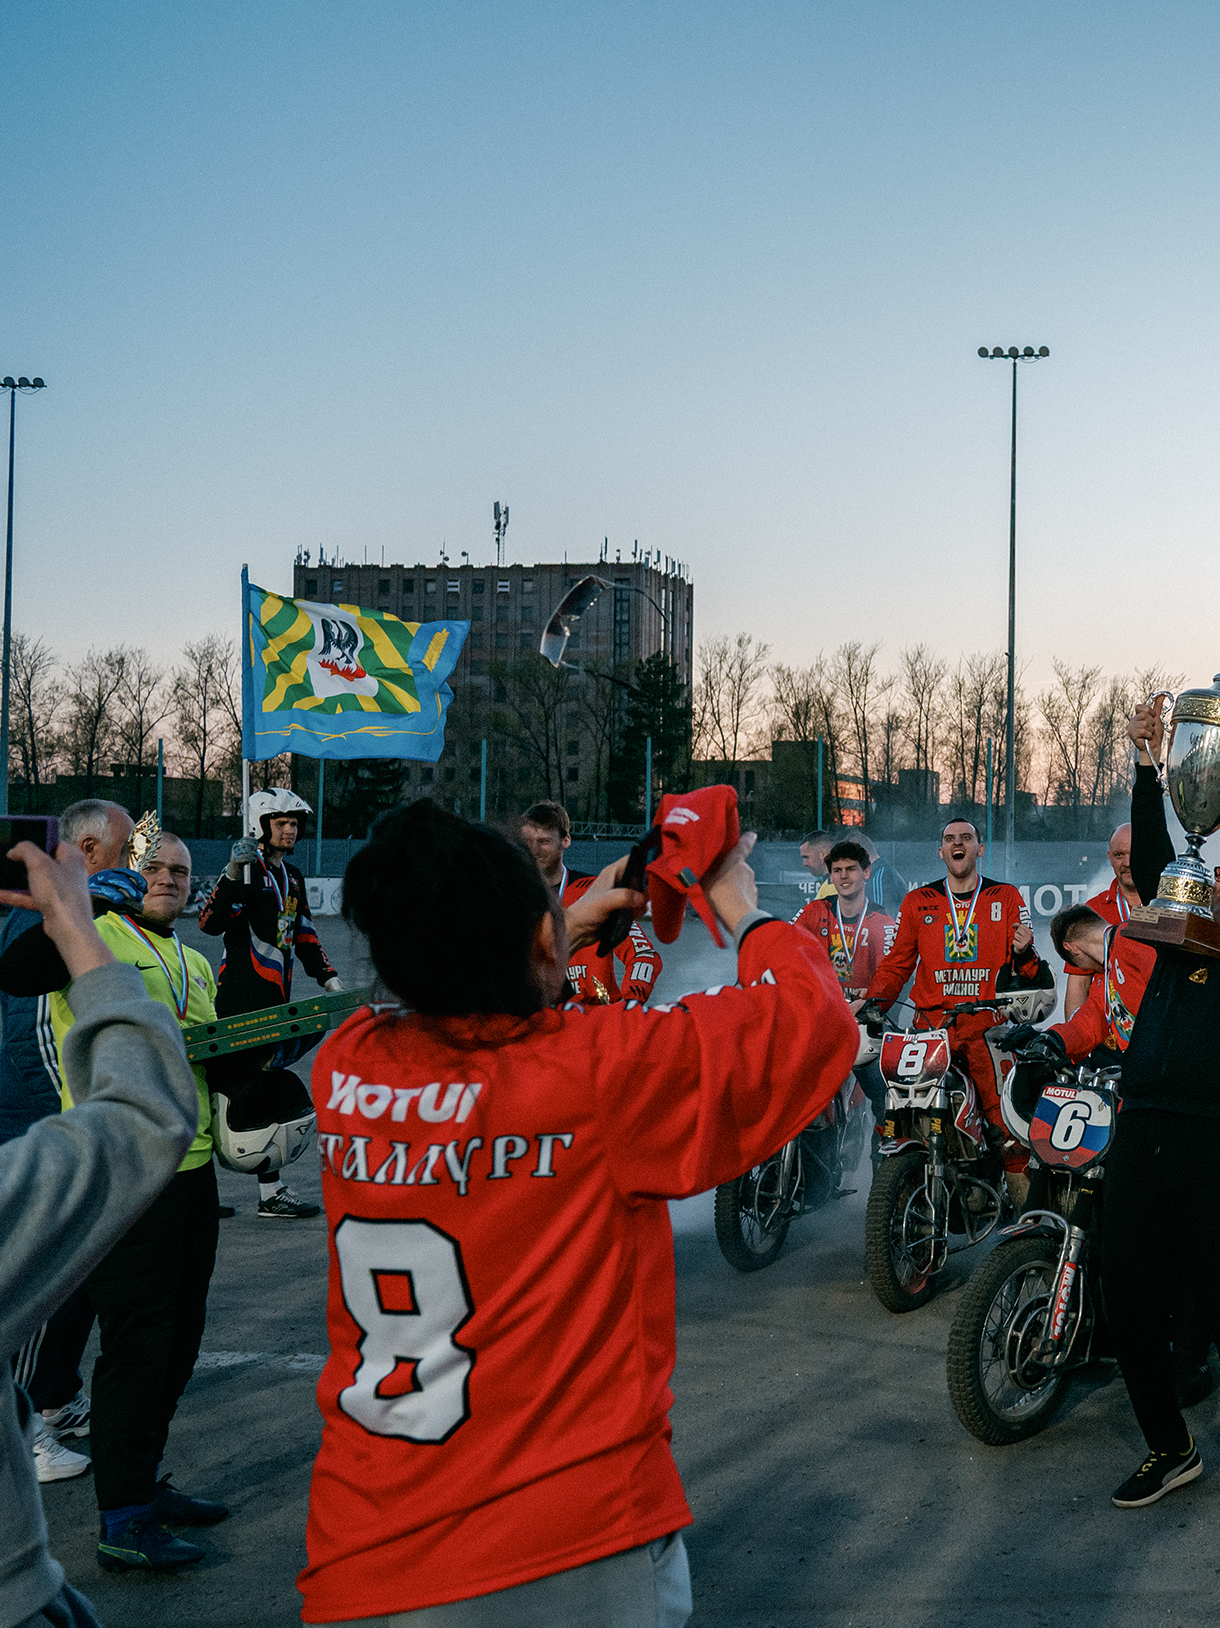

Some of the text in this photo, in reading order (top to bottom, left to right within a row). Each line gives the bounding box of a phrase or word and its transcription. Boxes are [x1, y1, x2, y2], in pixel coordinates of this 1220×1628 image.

[991, 901, 1002, 922] 8
[860, 927, 870, 947] 2
[630, 961, 654, 983] 10
[934, 968, 991, 984] МЕТАЛЛУРГ
[1114, 958, 1126, 985] 6
[897, 1041, 928, 1076] 8
[1046, 1087, 1077, 1099] MOTUL
[1050, 1101, 1092, 1152] 6
[334, 1212, 476, 1446] 8
